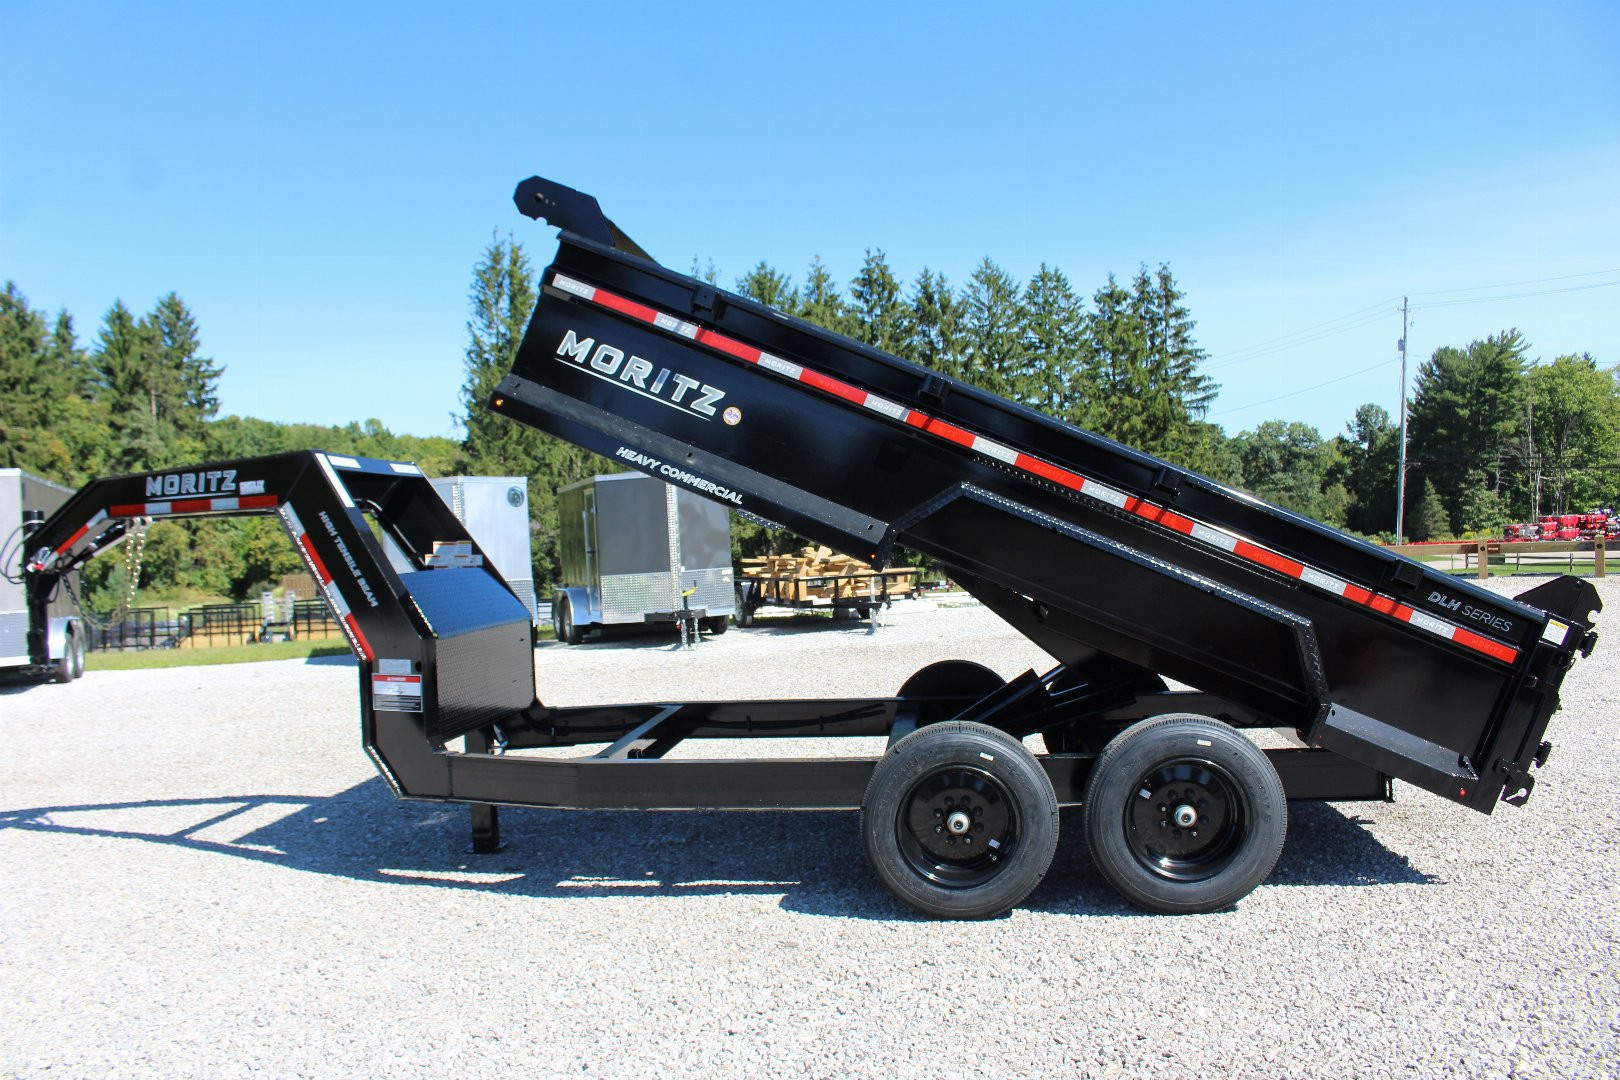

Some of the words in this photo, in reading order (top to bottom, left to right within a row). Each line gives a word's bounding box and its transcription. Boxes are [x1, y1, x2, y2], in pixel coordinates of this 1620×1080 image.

[559, 279, 590, 295] MORITZ
[659, 317, 692, 334] MORTZ
[556, 329, 726, 416] MORITZ
[764, 357, 797, 374] MORITZ
[870, 399, 902, 416] MORITZ
[978, 442, 1012, 459] MORITZ
[145, 469, 237, 497] MORITZ
[616, 446, 661, 470] HEAVY
[660, 464, 743, 505] COMMERCIAL
[1088, 485, 1121, 503] MORITZ
[1198, 529, 1231, 546] MORITZ
[318, 510, 339, 537] HIGH
[333, 535, 362, 578] TENSILE
[357, 577, 379, 608] BEAM
[1306, 572, 1340, 591] MORITZ
[1427, 591, 1462, 612] DLH
[1461, 605, 1513, 633] SERIES
[1416, 615, 1450, 634] MORITZ
